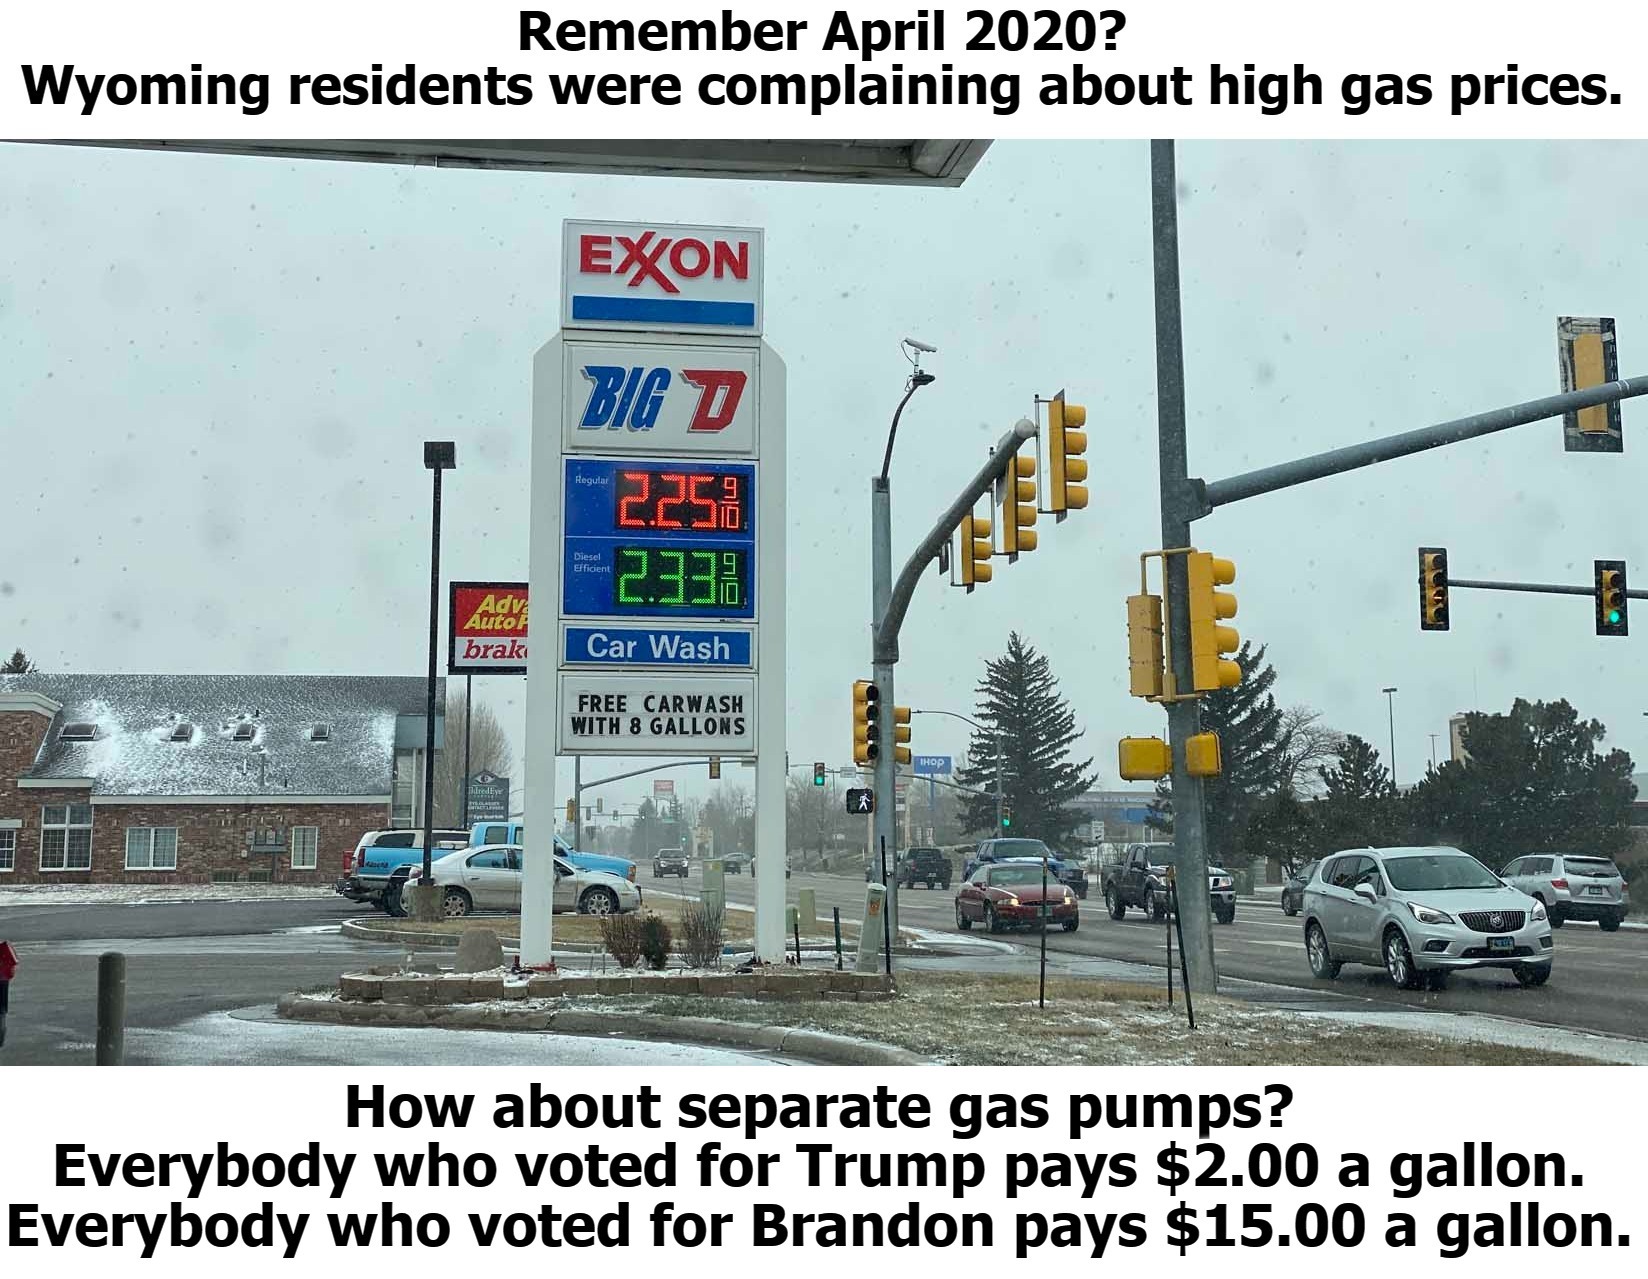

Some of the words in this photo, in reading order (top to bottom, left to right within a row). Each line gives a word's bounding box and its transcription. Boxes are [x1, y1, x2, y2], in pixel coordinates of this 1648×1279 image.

[579, 231, 749, 294] EXXON
[579, 365, 672, 432] BIG
[682, 369, 749, 433] D
[575, 475, 609, 487] Regular
[619, 473, 717, 528] 2.25
[573, 552, 601, 562] Diesel
[573, 563, 611, 574] Efficient
[618, 550, 717, 604] 2.33
[587, 632, 638, 658] Car
[649, 634, 731, 661] Wash
[578, 694, 627, 713] FREE
[643, 695, 744, 714] CARWASH
[571, 717, 621, 735] WITH
[629, 717, 641, 735] 8
[650, 717, 746, 736] GALLONS
